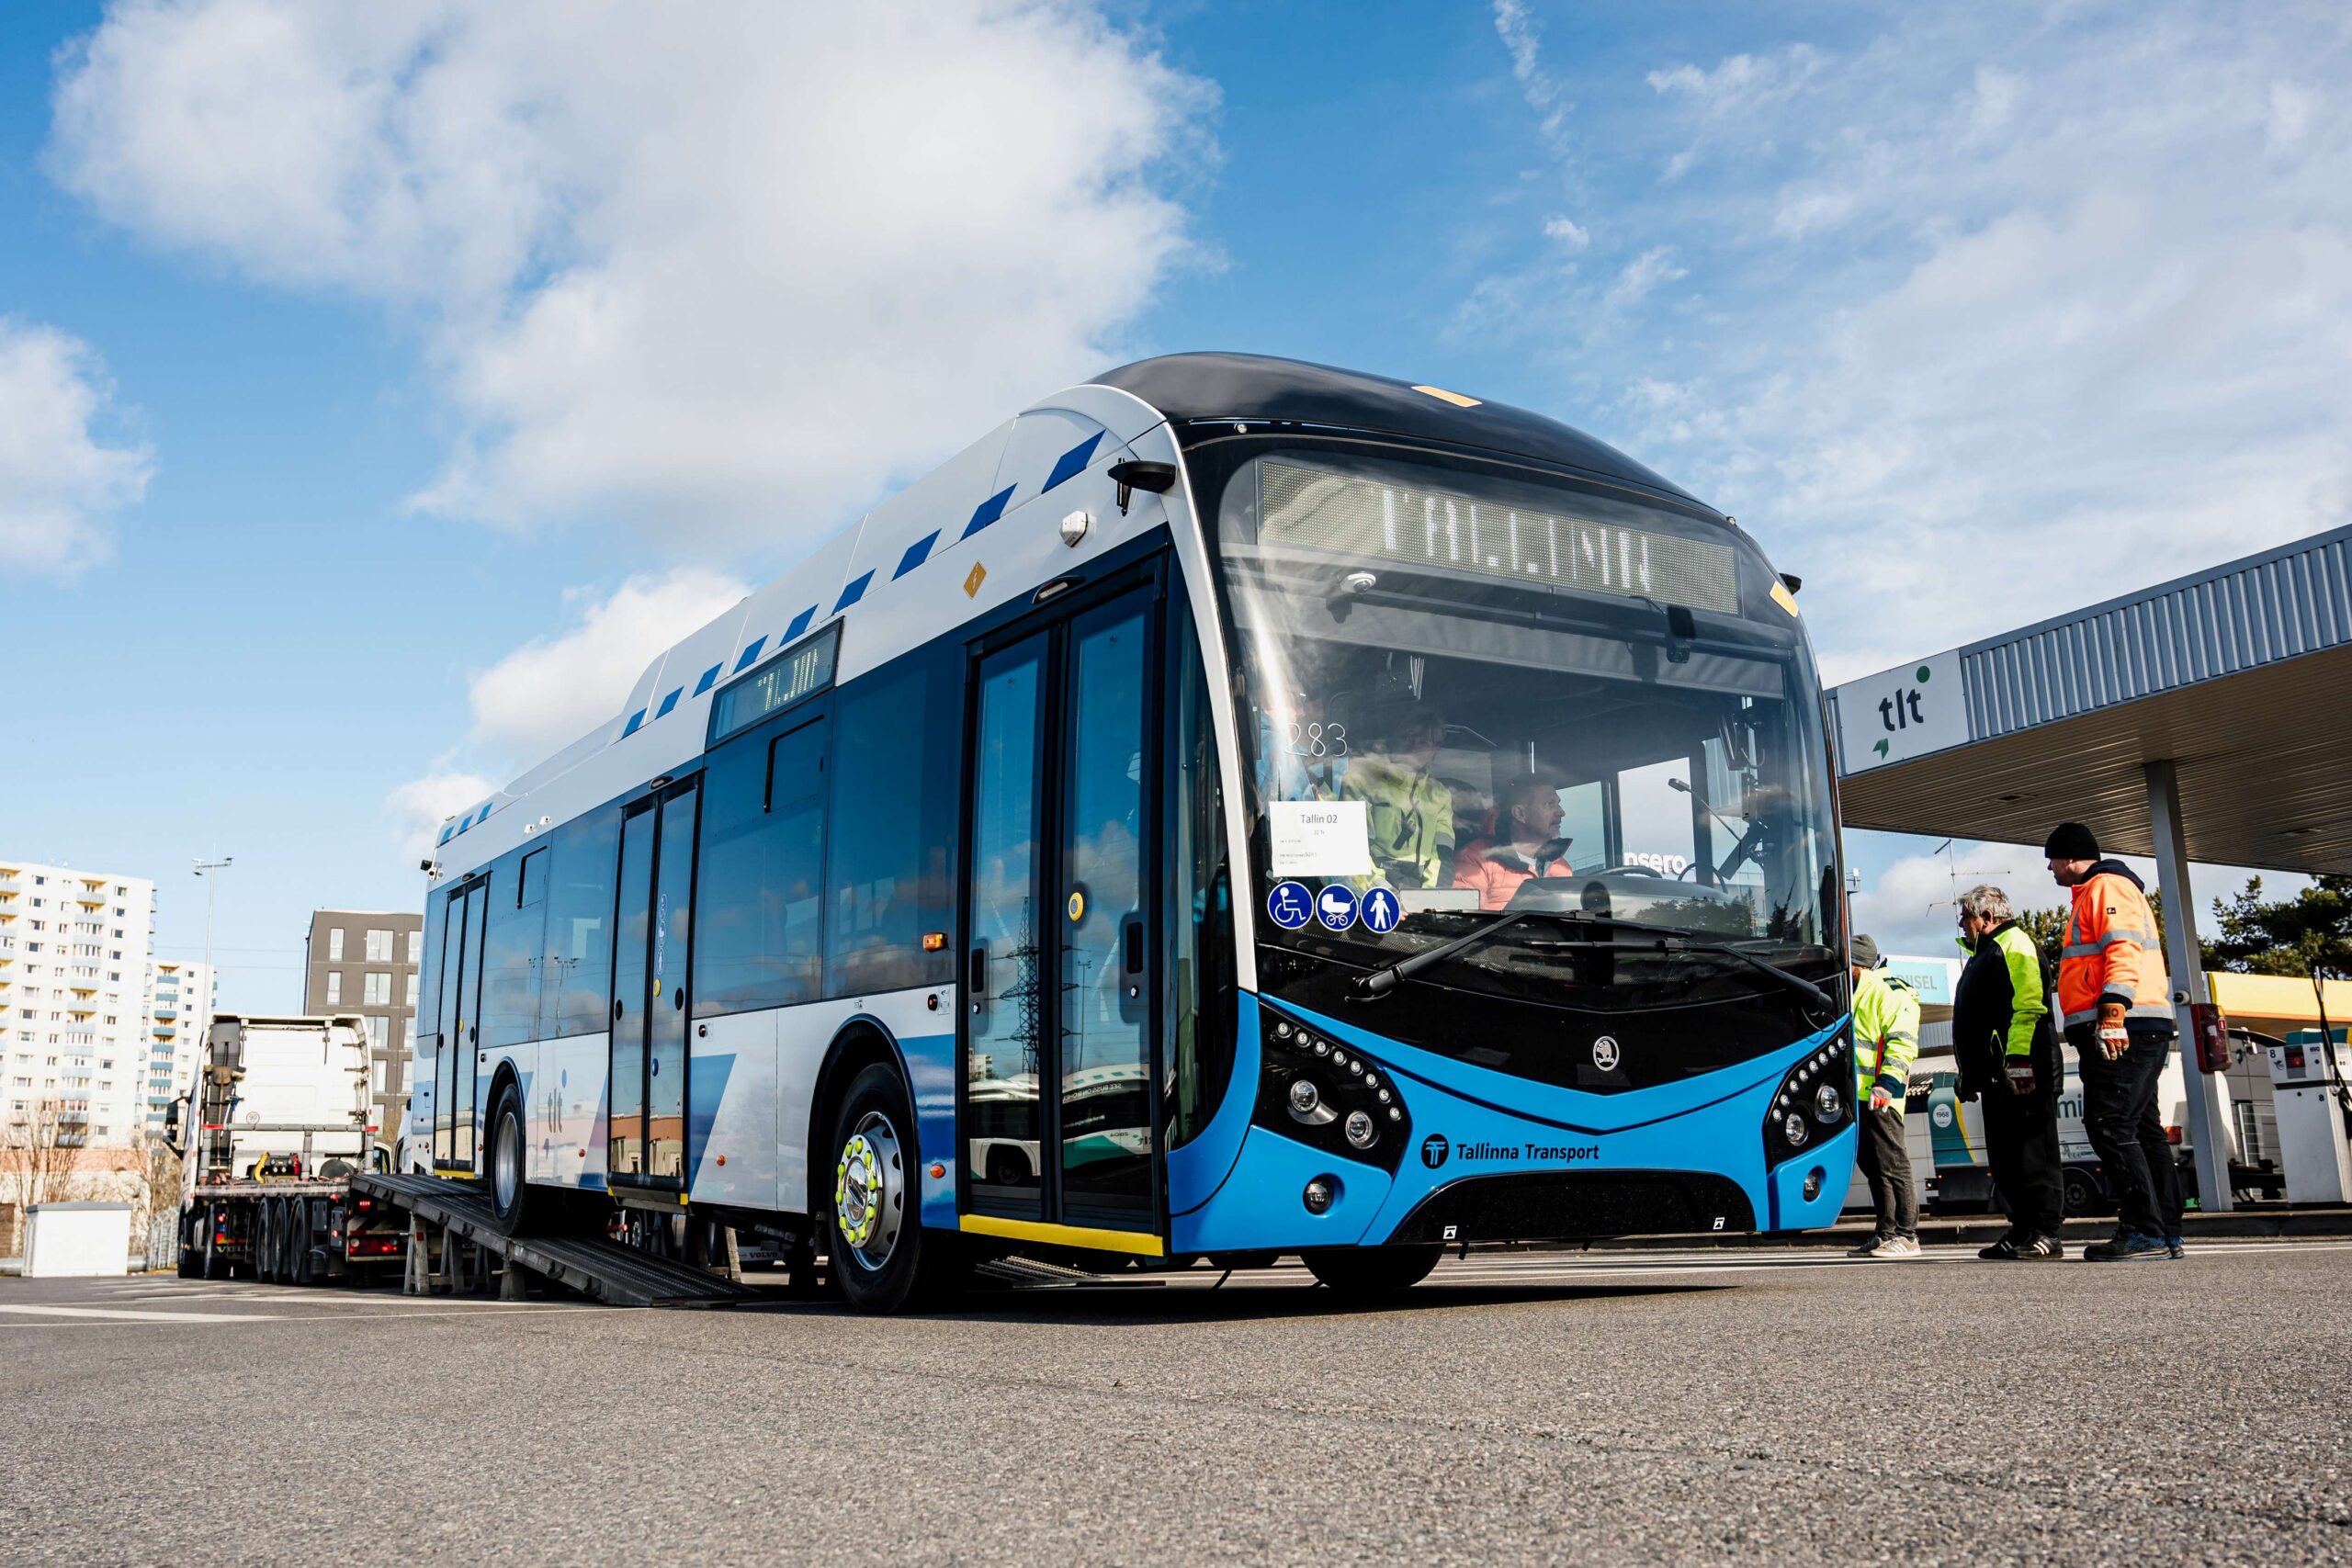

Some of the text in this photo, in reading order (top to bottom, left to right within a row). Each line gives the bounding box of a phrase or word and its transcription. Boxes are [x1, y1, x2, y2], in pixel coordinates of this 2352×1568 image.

[1879, 688, 1924, 731] tlt
[1284, 722, 1347, 757] 283
[1300, 814, 1338, 824] Tallin 02
[2269, 1049, 2276, 1058] 8
[548, 1087, 563, 1134] tlt
[1456, 1143, 1600, 1163] Tallinna Transport
